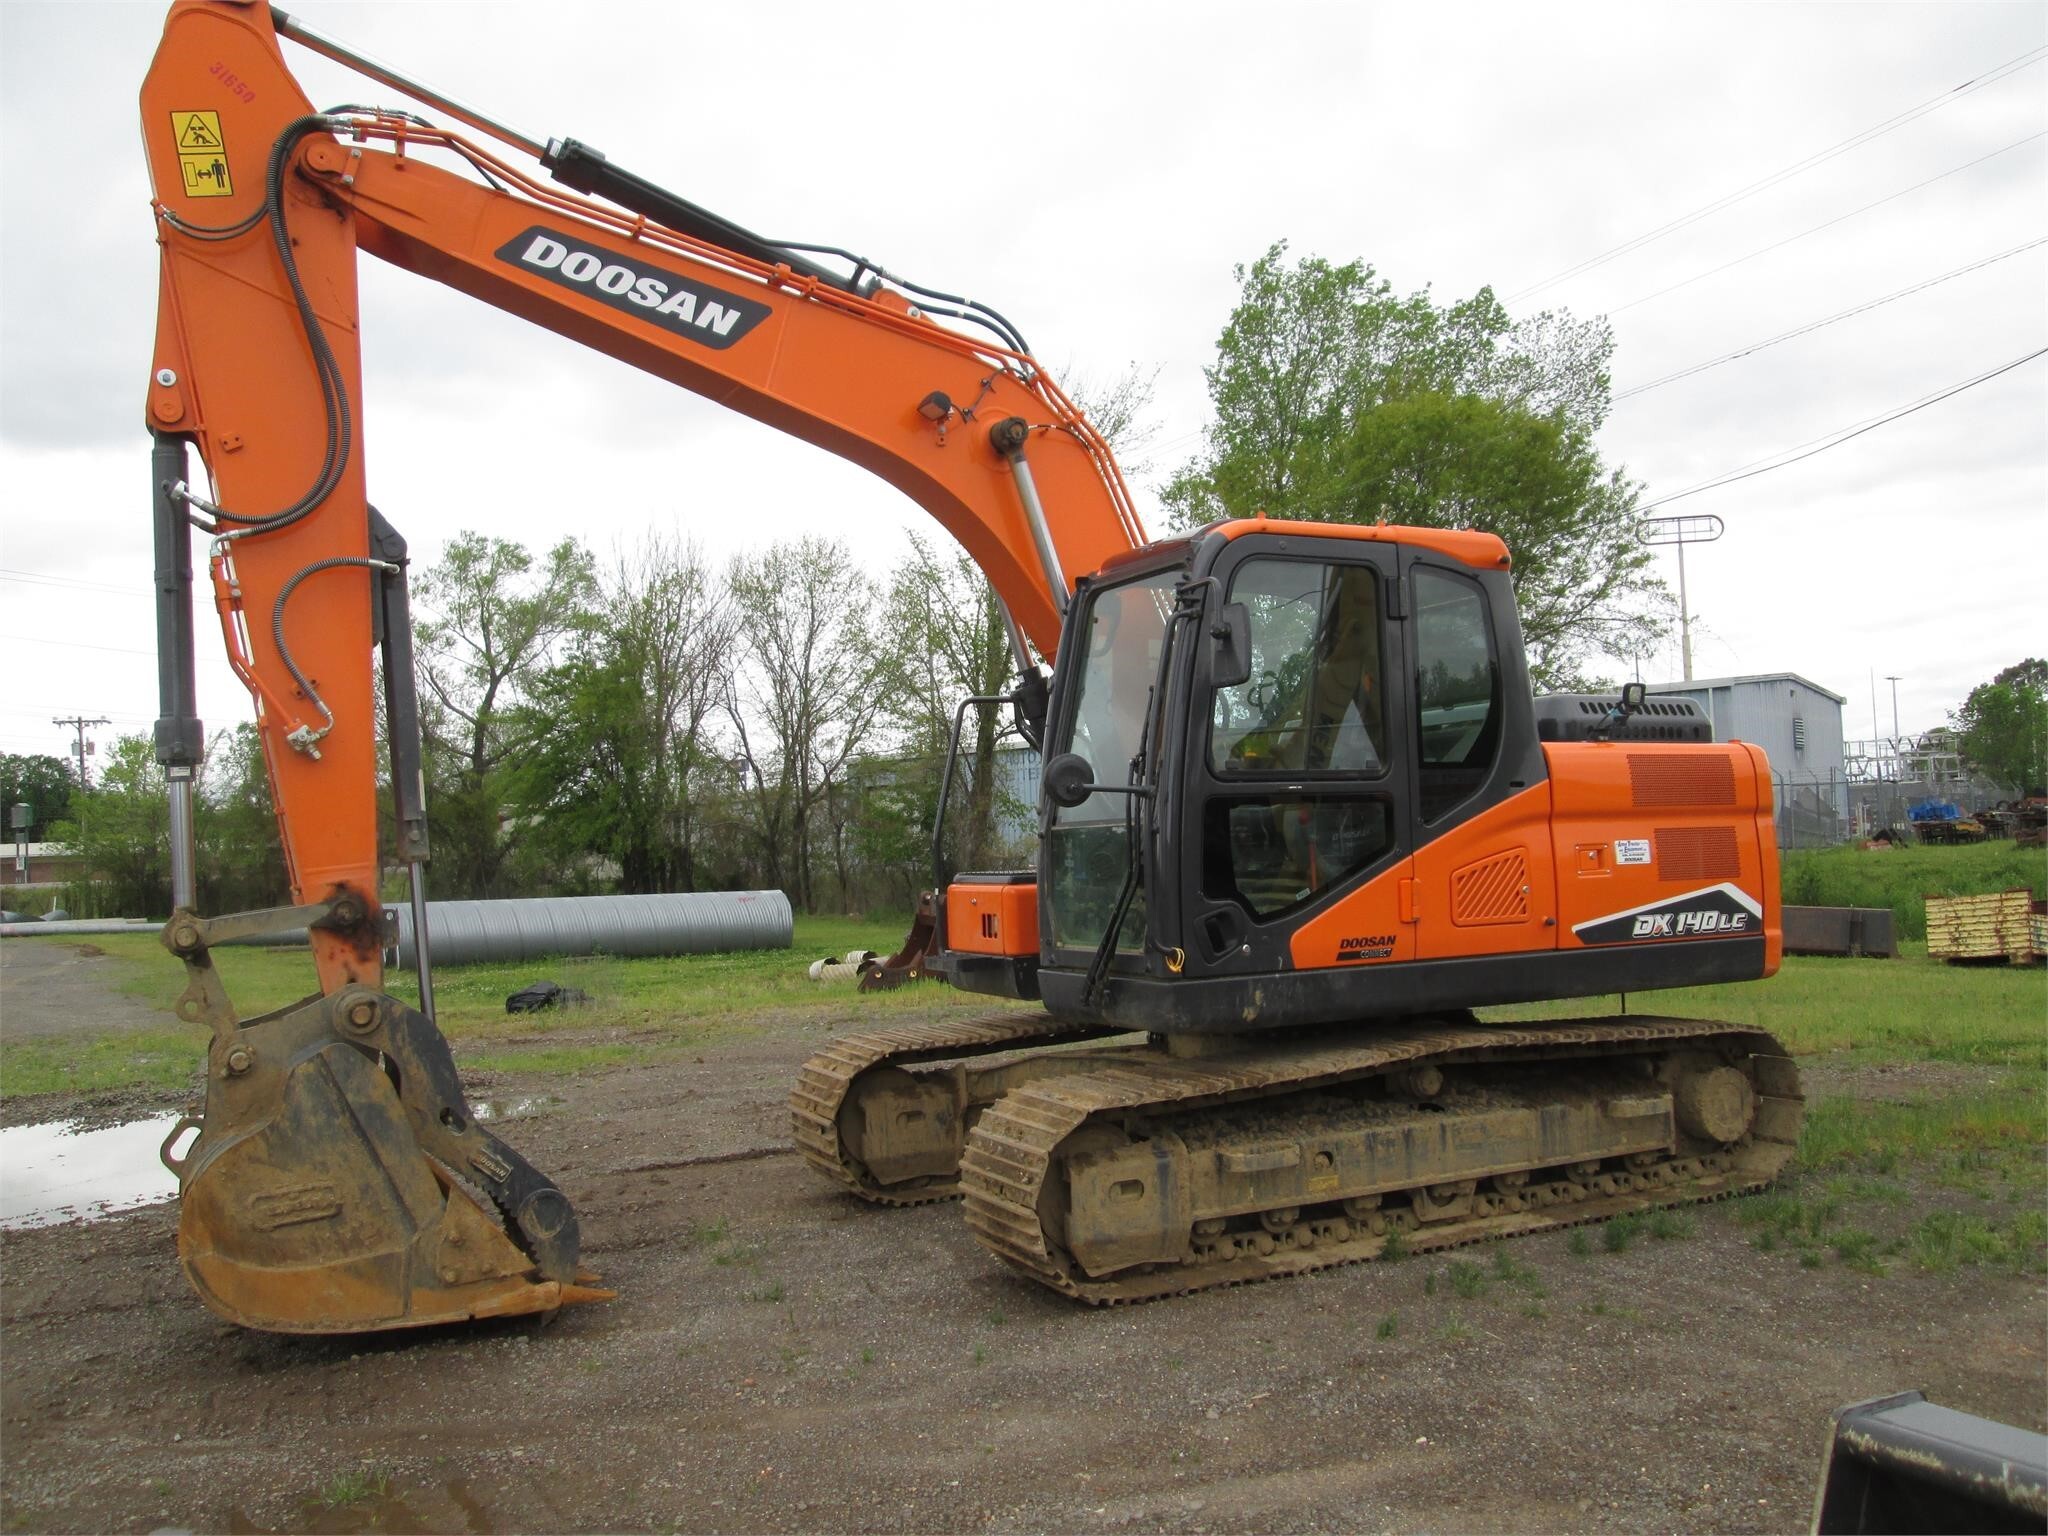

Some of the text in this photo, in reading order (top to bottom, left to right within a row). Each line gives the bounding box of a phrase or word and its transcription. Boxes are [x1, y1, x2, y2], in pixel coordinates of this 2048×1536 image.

[210, 61, 256, 104] 31650
[521, 235, 741, 336] DOOSAN
[1340, 935, 1396, 948] DOOSAN
[1360, 948, 1391, 958] CONNECT
